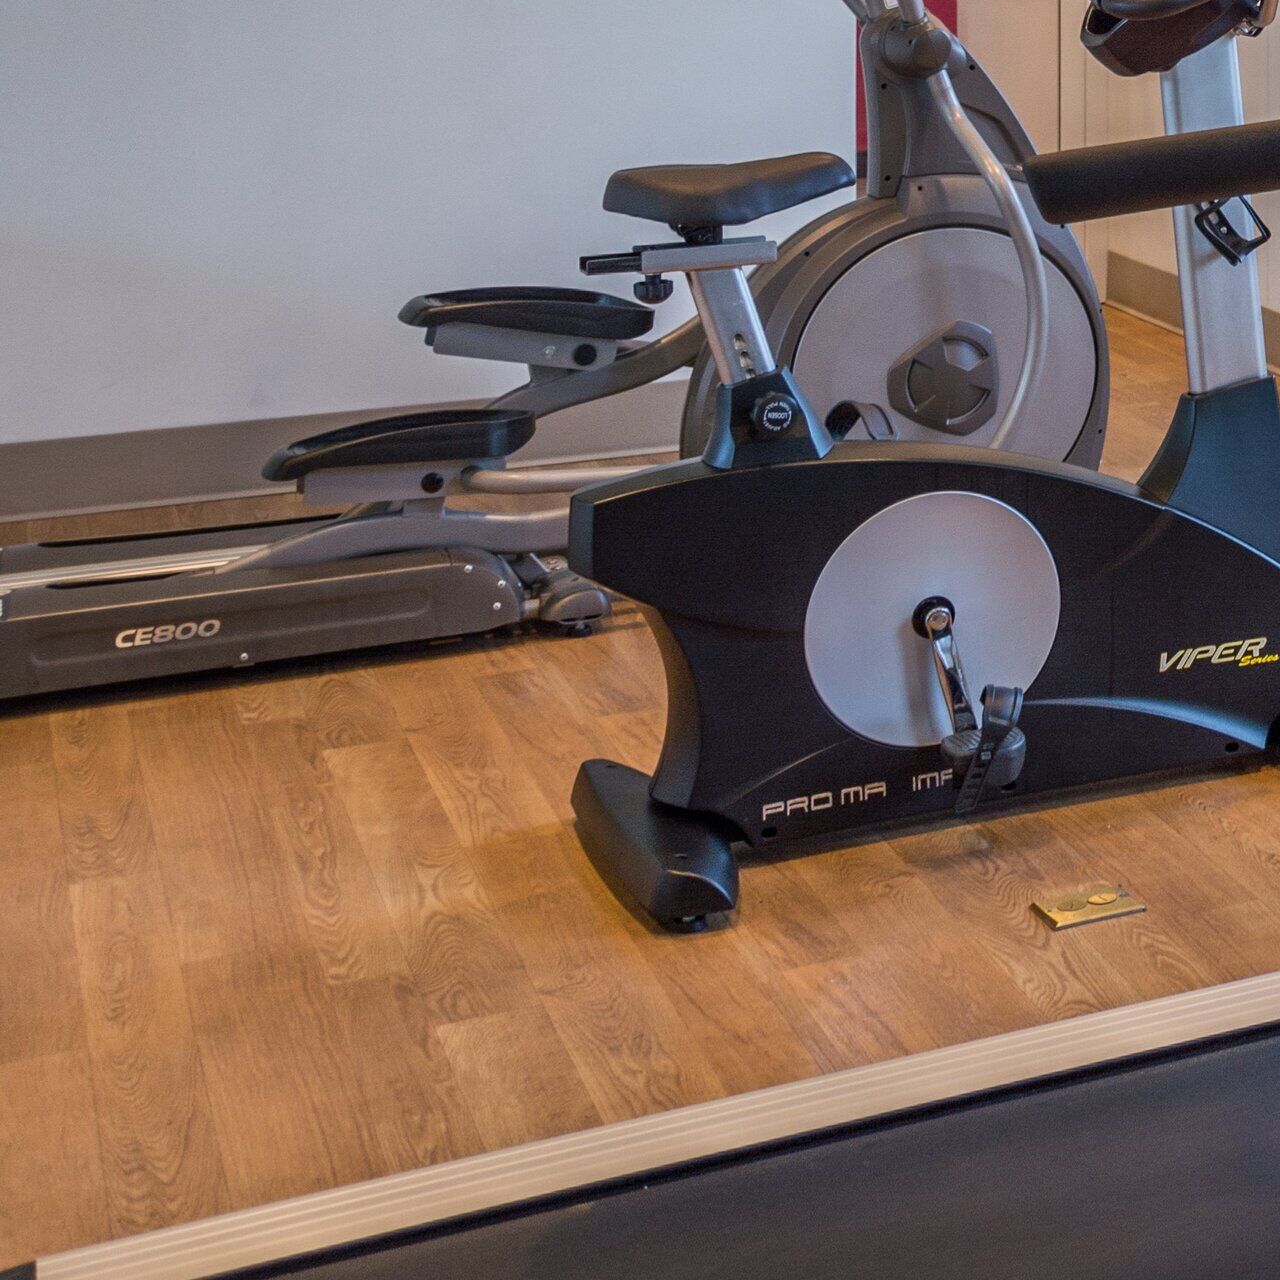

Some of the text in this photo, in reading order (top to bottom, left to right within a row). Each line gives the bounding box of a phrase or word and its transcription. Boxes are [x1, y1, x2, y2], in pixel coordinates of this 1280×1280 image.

[114, 619, 221, 649] CE800
[1159, 636, 1268, 673] VIPER
[1238, 654, 1280, 667] Series
[762, 790, 833, 821] PRO
